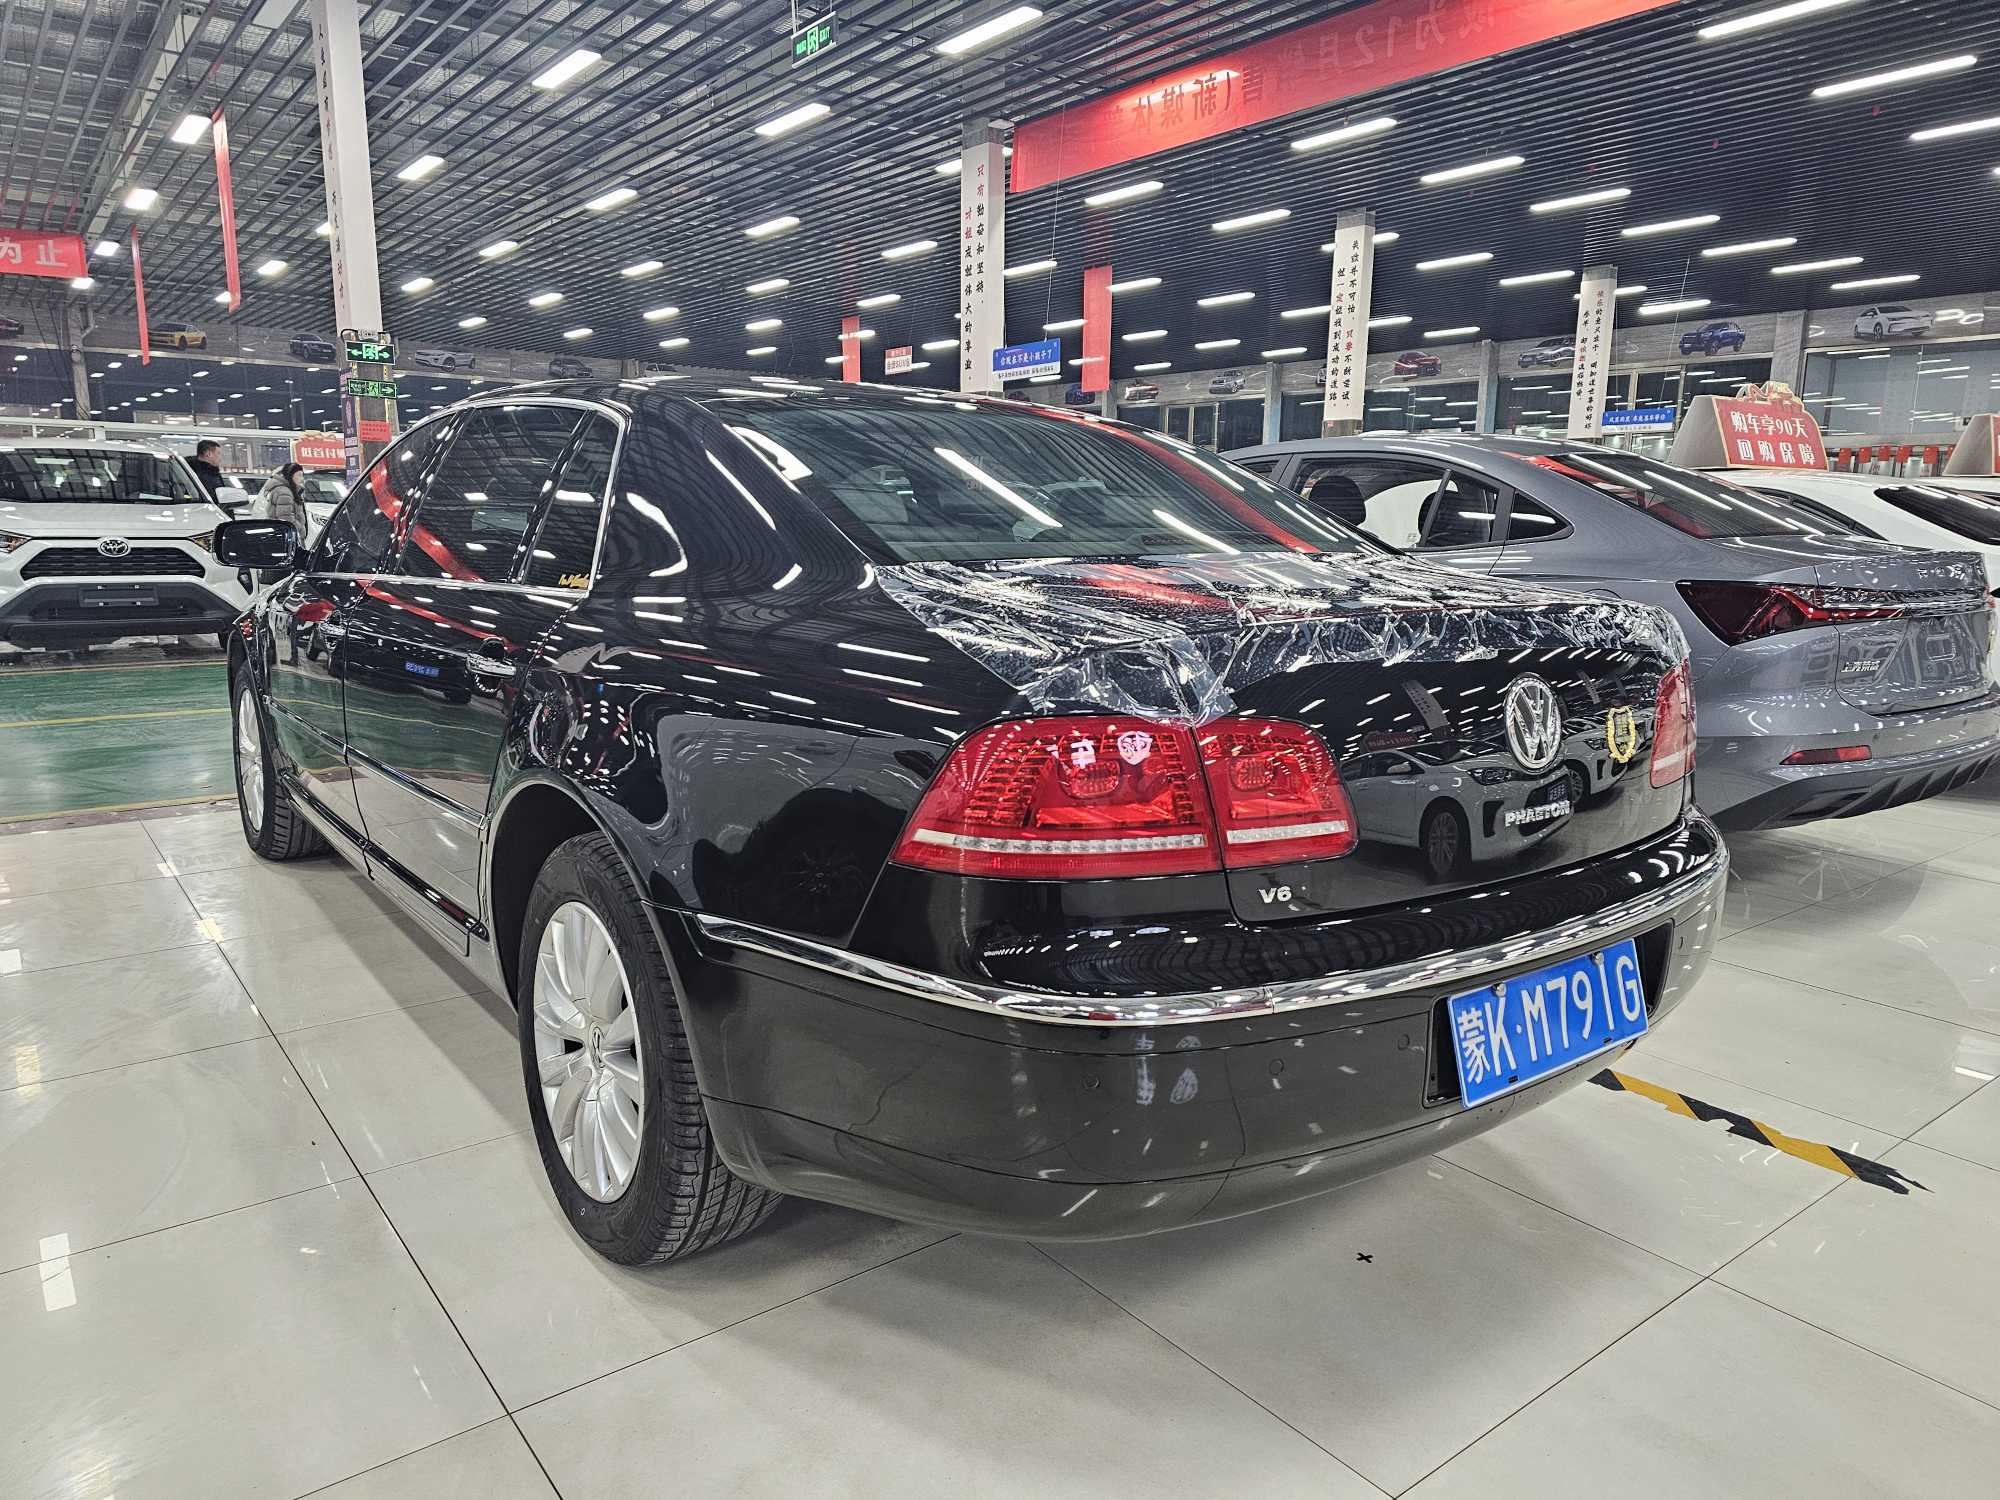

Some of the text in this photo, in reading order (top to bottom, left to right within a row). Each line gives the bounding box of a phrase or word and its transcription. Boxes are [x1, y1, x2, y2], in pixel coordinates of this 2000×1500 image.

[820, 26, 831, 43] EXIT
[0, 236, 68, 267] 为止
[1730, 410, 1809, 439] 购车享90天
[1737, 438, 1816, 465] 回购保障
[1504, 800, 1570, 828] PHAETON
[1258, 885, 1292, 904] V6
[1456, 954, 1642, 1085] 蒙K·M791G
